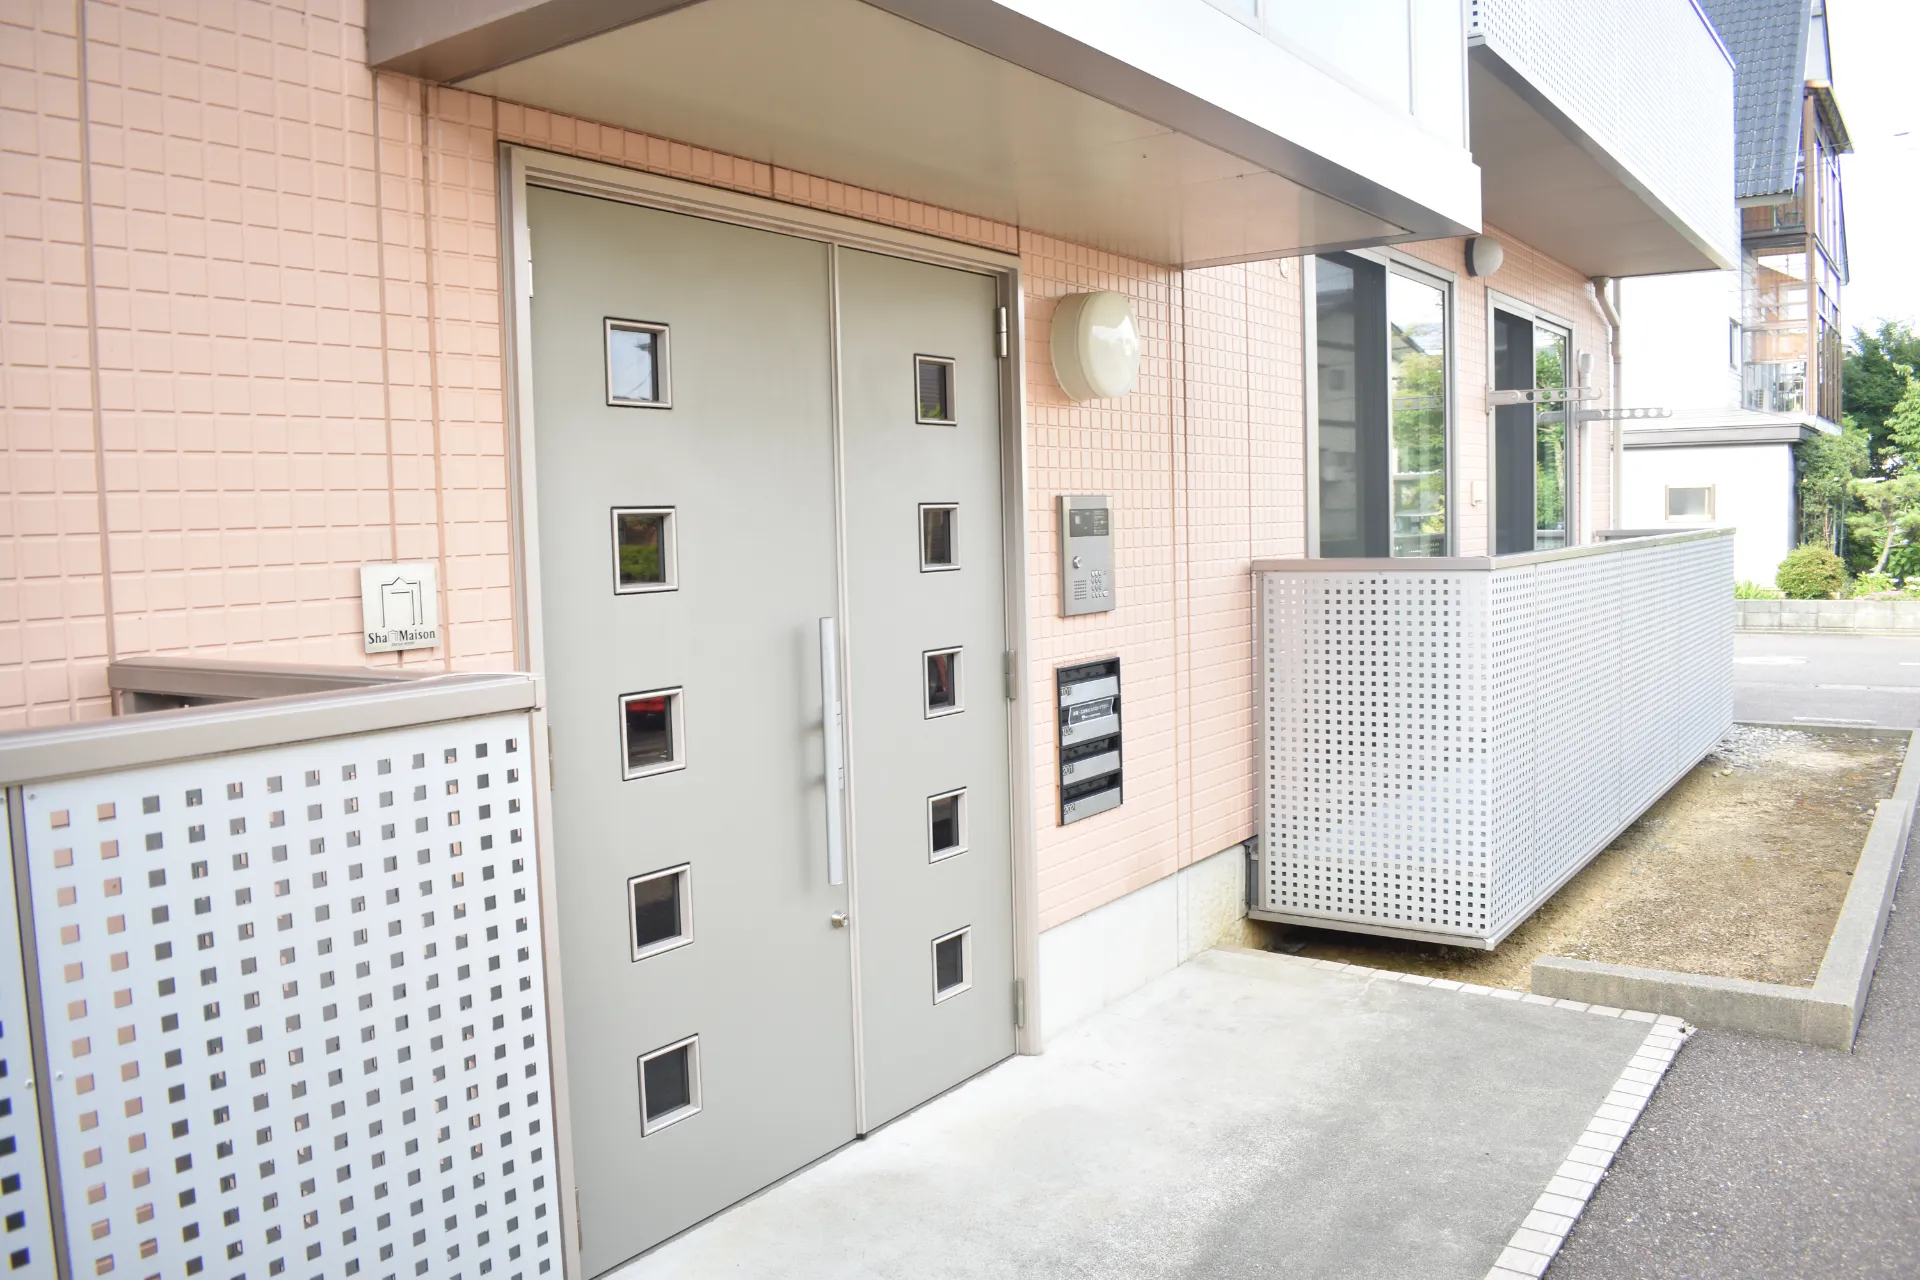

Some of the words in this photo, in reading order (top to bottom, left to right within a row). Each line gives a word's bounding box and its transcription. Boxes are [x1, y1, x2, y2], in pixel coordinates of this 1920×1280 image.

[368, 632, 388, 645] Sha
[399, 629, 436, 642] Maison
[1062, 763, 1074, 776] 201
[1063, 803, 1075, 815] 202
